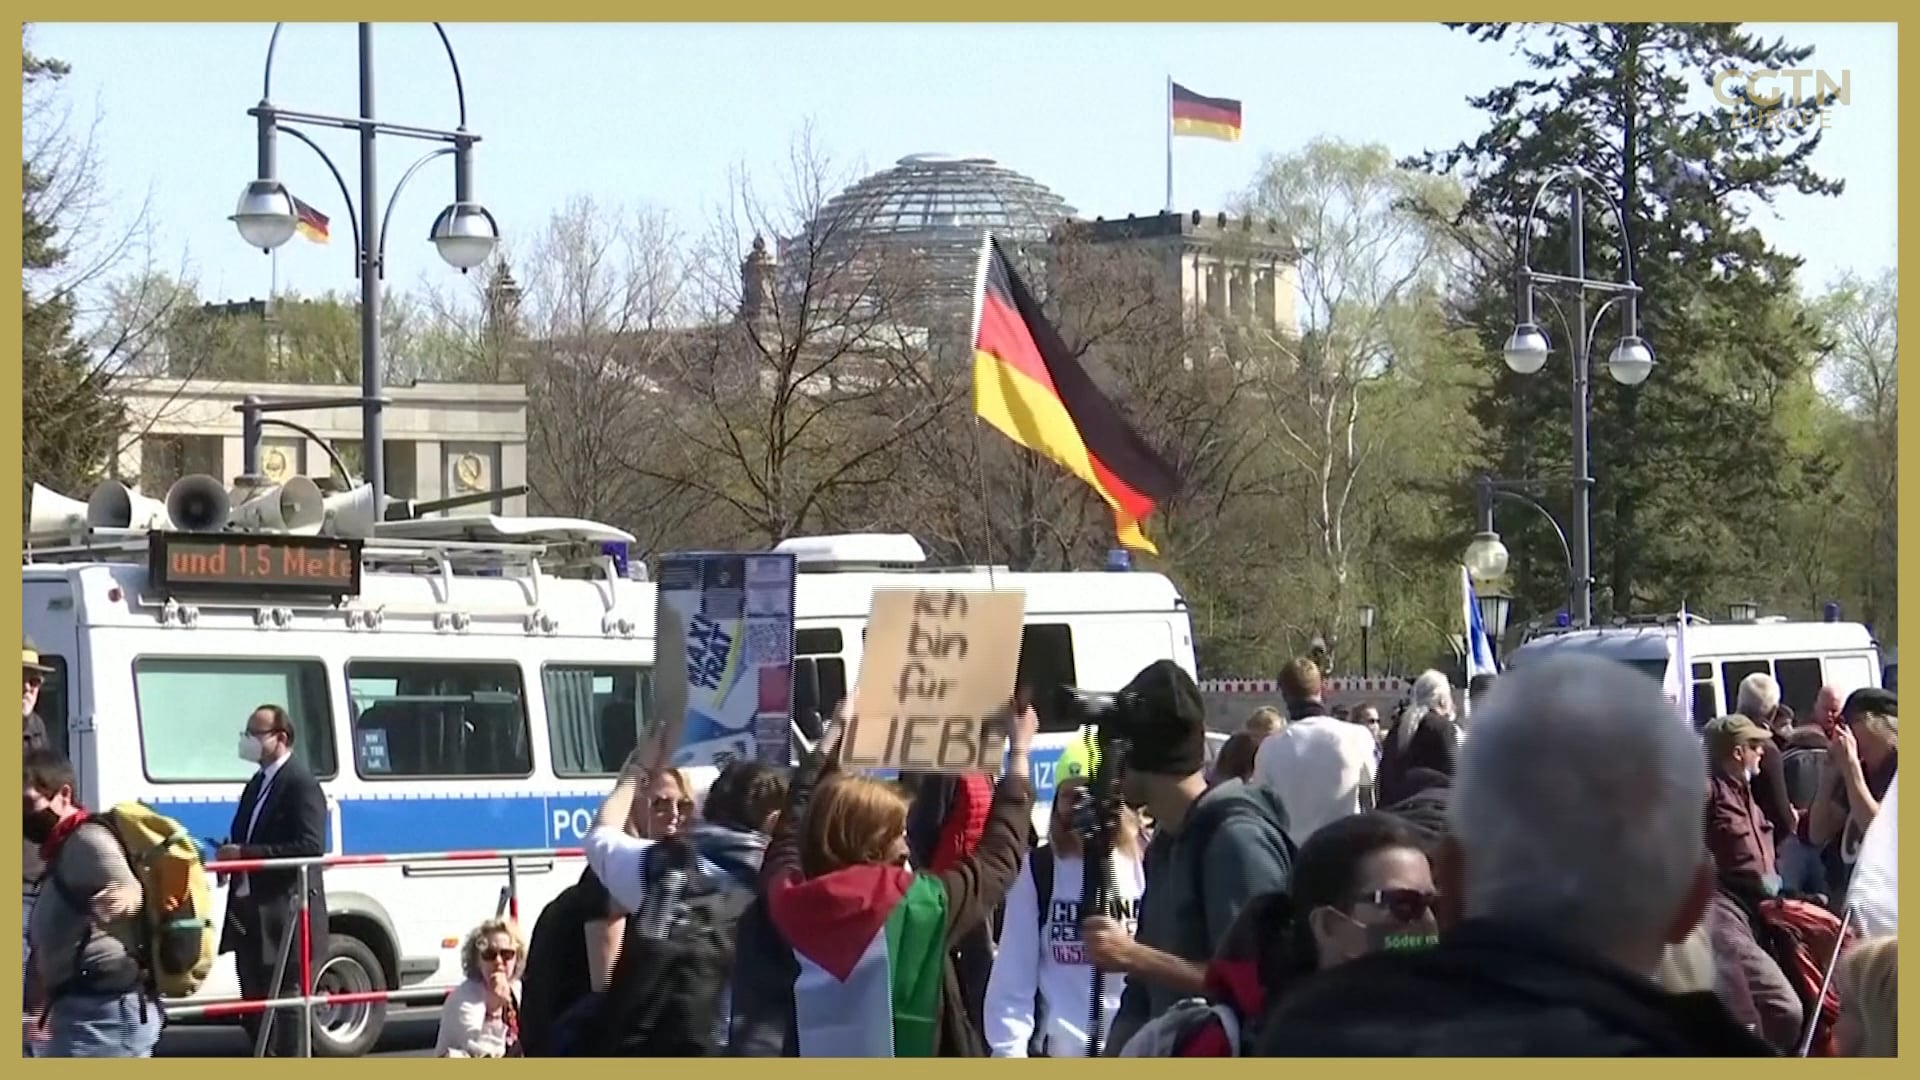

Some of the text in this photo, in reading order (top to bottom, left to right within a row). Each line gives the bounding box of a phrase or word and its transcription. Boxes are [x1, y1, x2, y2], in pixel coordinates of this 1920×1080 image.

[172, 544, 226, 574] und
[686, 613, 714, 688] MAXI
[907, 621, 969, 661] bin
[893, 661, 961, 704] für
[842, 714, 1008, 770] LIEBE
